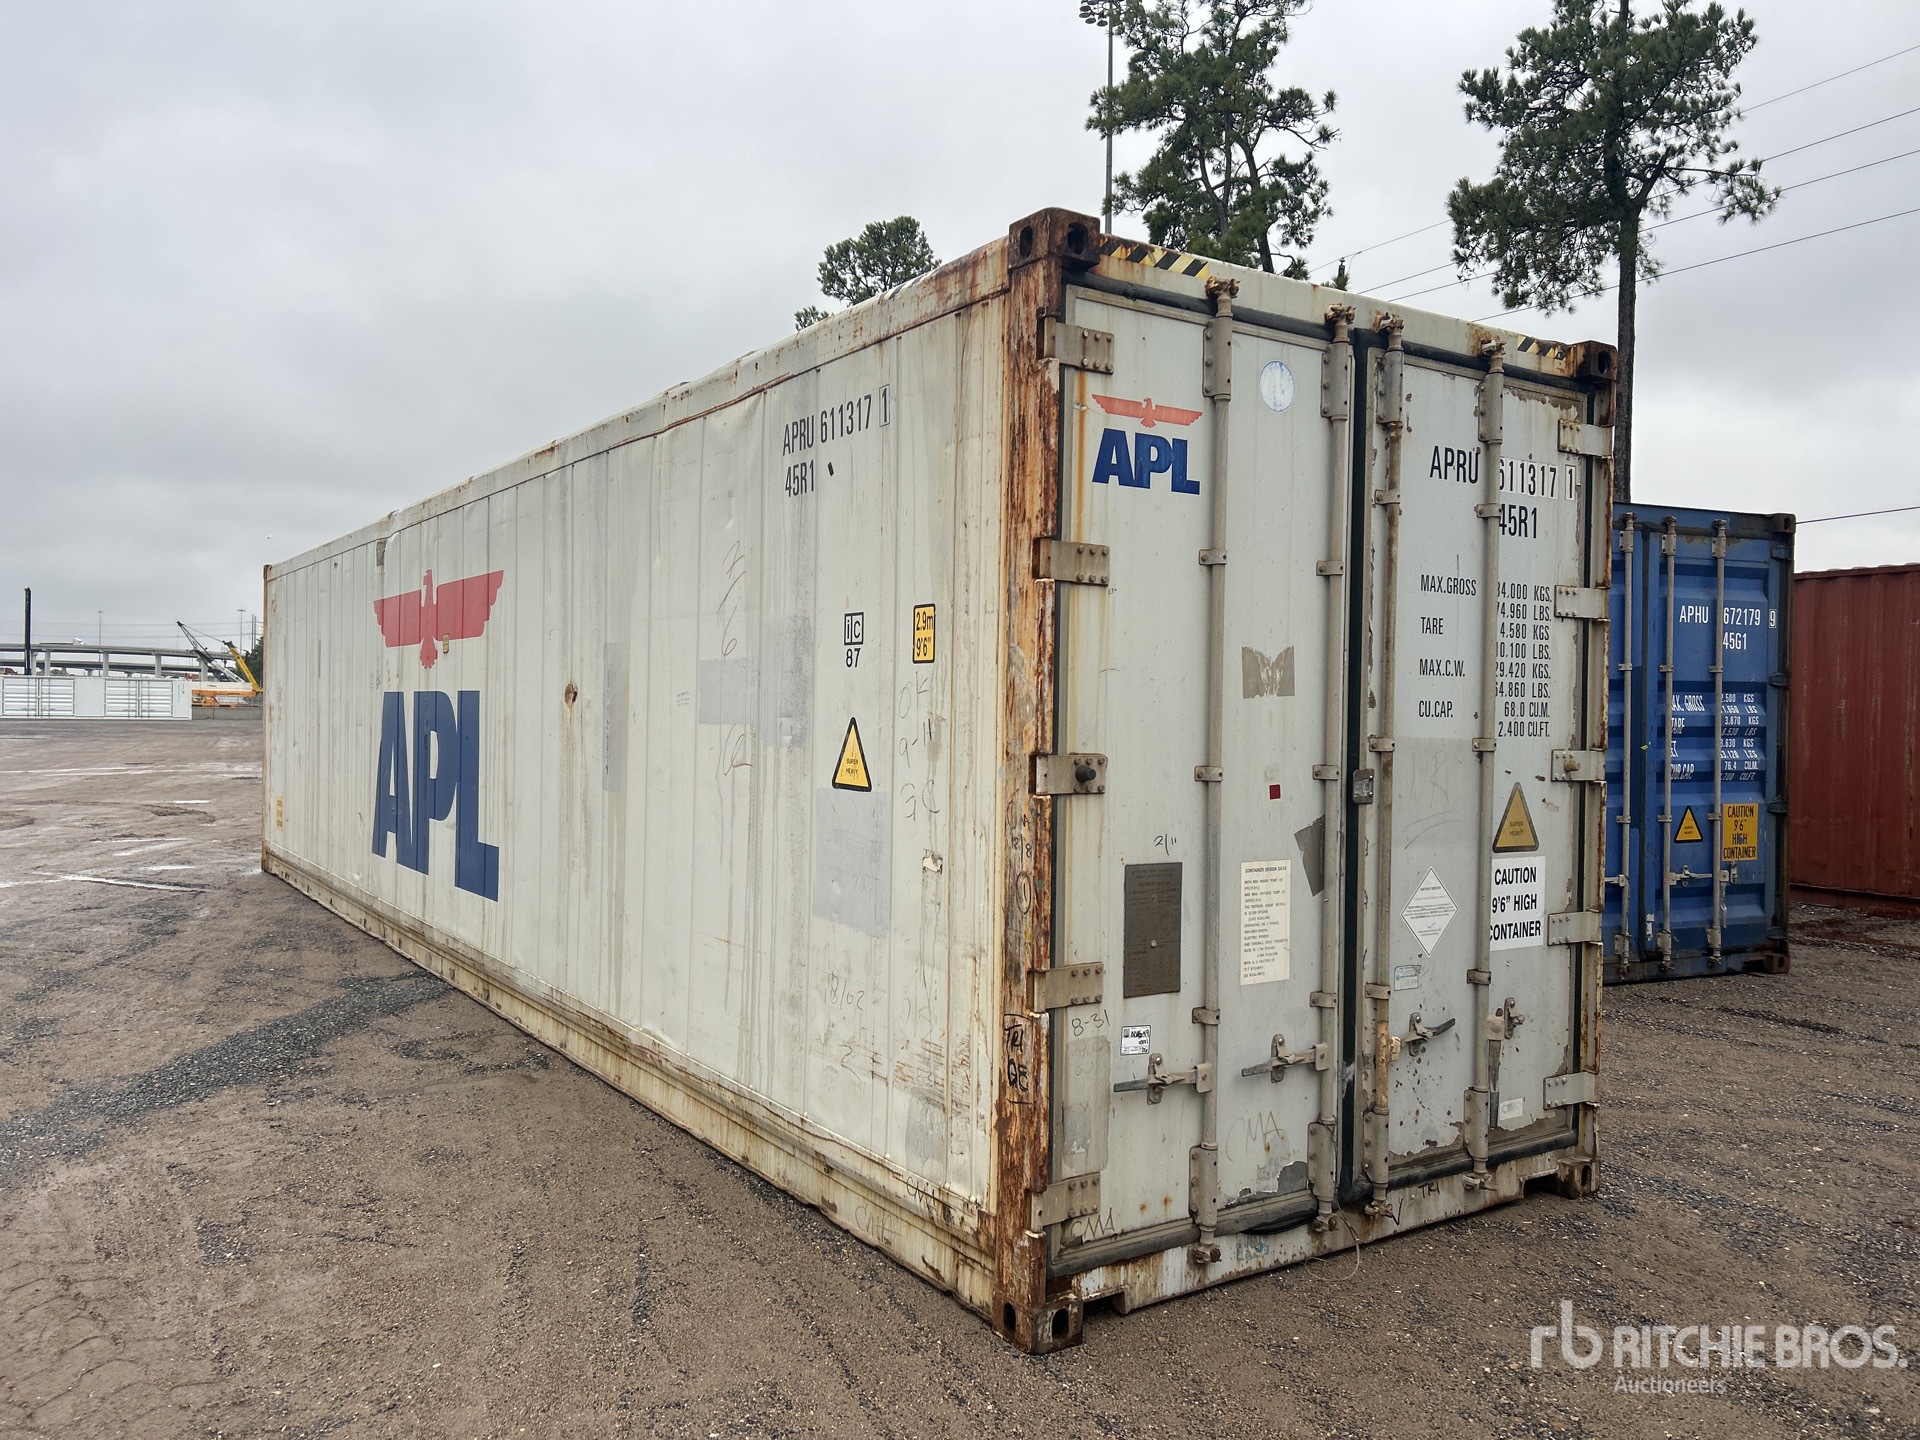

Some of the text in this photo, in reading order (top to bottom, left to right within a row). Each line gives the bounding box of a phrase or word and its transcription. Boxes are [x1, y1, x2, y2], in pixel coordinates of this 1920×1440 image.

[782, 415, 815, 456] APRU
[820, 394, 872, 444] 611317
[1091, 427, 1201, 496] APL
[1429, 445, 1479, 485] APRU
[785, 459, 815, 498] 45R1
[1499, 503, 1538, 539] 45R1
[1534, 605, 1552, 622] LBS.
[1679, 605, 1709, 624] APHU
[1723, 607, 1761, 626] 672179
[1420, 616, 1444, 635] TARE
[1722, 632, 1748, 650] 45G1
[845, 647, 862, 668] 87
[1532, 643, 1552, 660] LBS.
[1532, 662, 1551, 680] KGS.
[1532, 682, 1551, 699] LBS.
[1504, 701, 1526, 718] 68.0
[1671, 694, 1685, 712] AX.
[1721, 693, 1736, 703] 2.500
[1743, 693, 1755, 703] KGS
[371, 689, 500, 903] APL
[1727, 806, 1755, 819] CAUTION
[1731, 832, 1748, 846] HIGH
[1723, 846, 1757, 861] CONTAINER
[1494, 866, 1537, 885] CAUTION
[1513, 893, 1538, 911] HIGH
[1070, 1207, 1115, 1239] CMA
